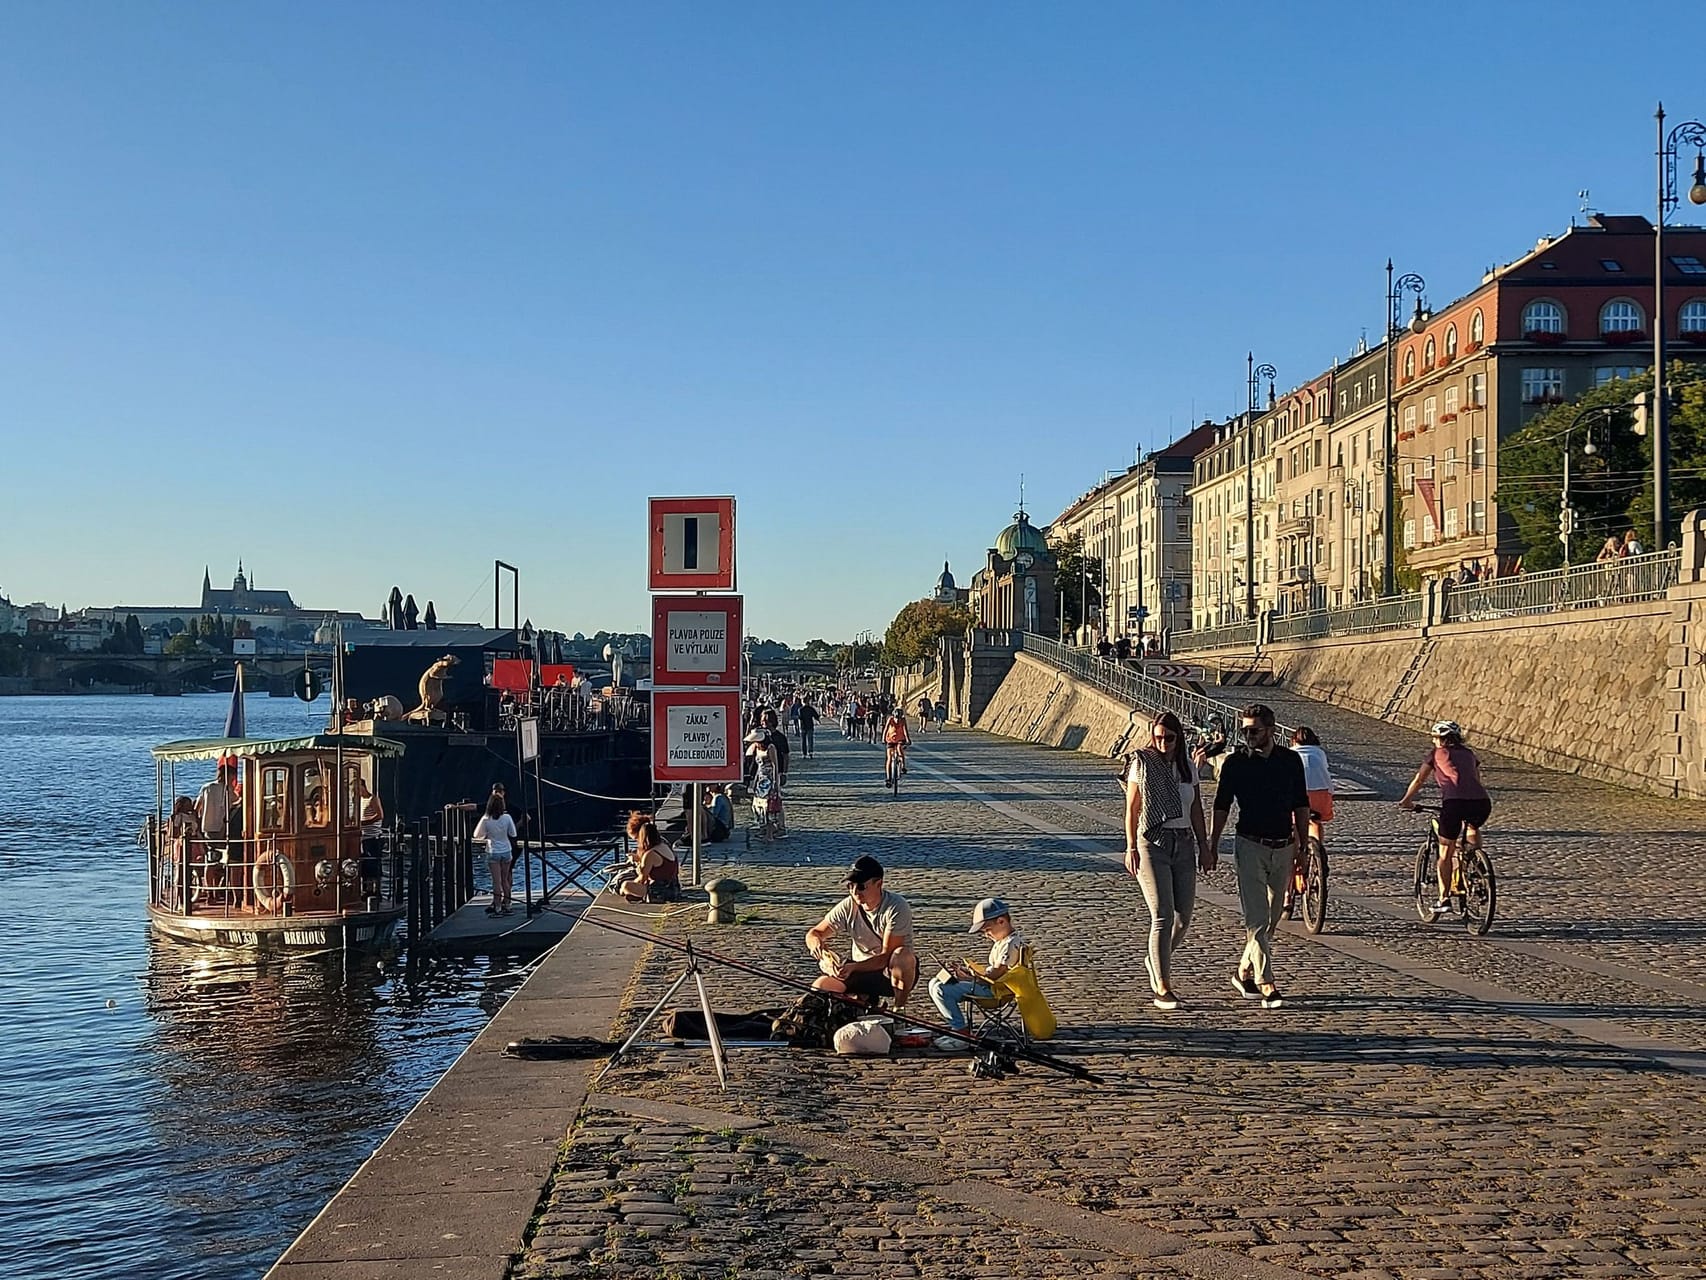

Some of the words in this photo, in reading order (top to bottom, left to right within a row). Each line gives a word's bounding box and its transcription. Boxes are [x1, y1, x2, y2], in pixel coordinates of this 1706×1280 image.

[669, 629, 698, 640] PLAVBA
[699, 629, 725, 640] POUZE
[674, 643, 684, 654] VE
[685, 641, 719, 655] VÝTLAKU
[685, 713, 709, 725] ZÁKAZ
[683, 732, 710, 743] PLAVBY
